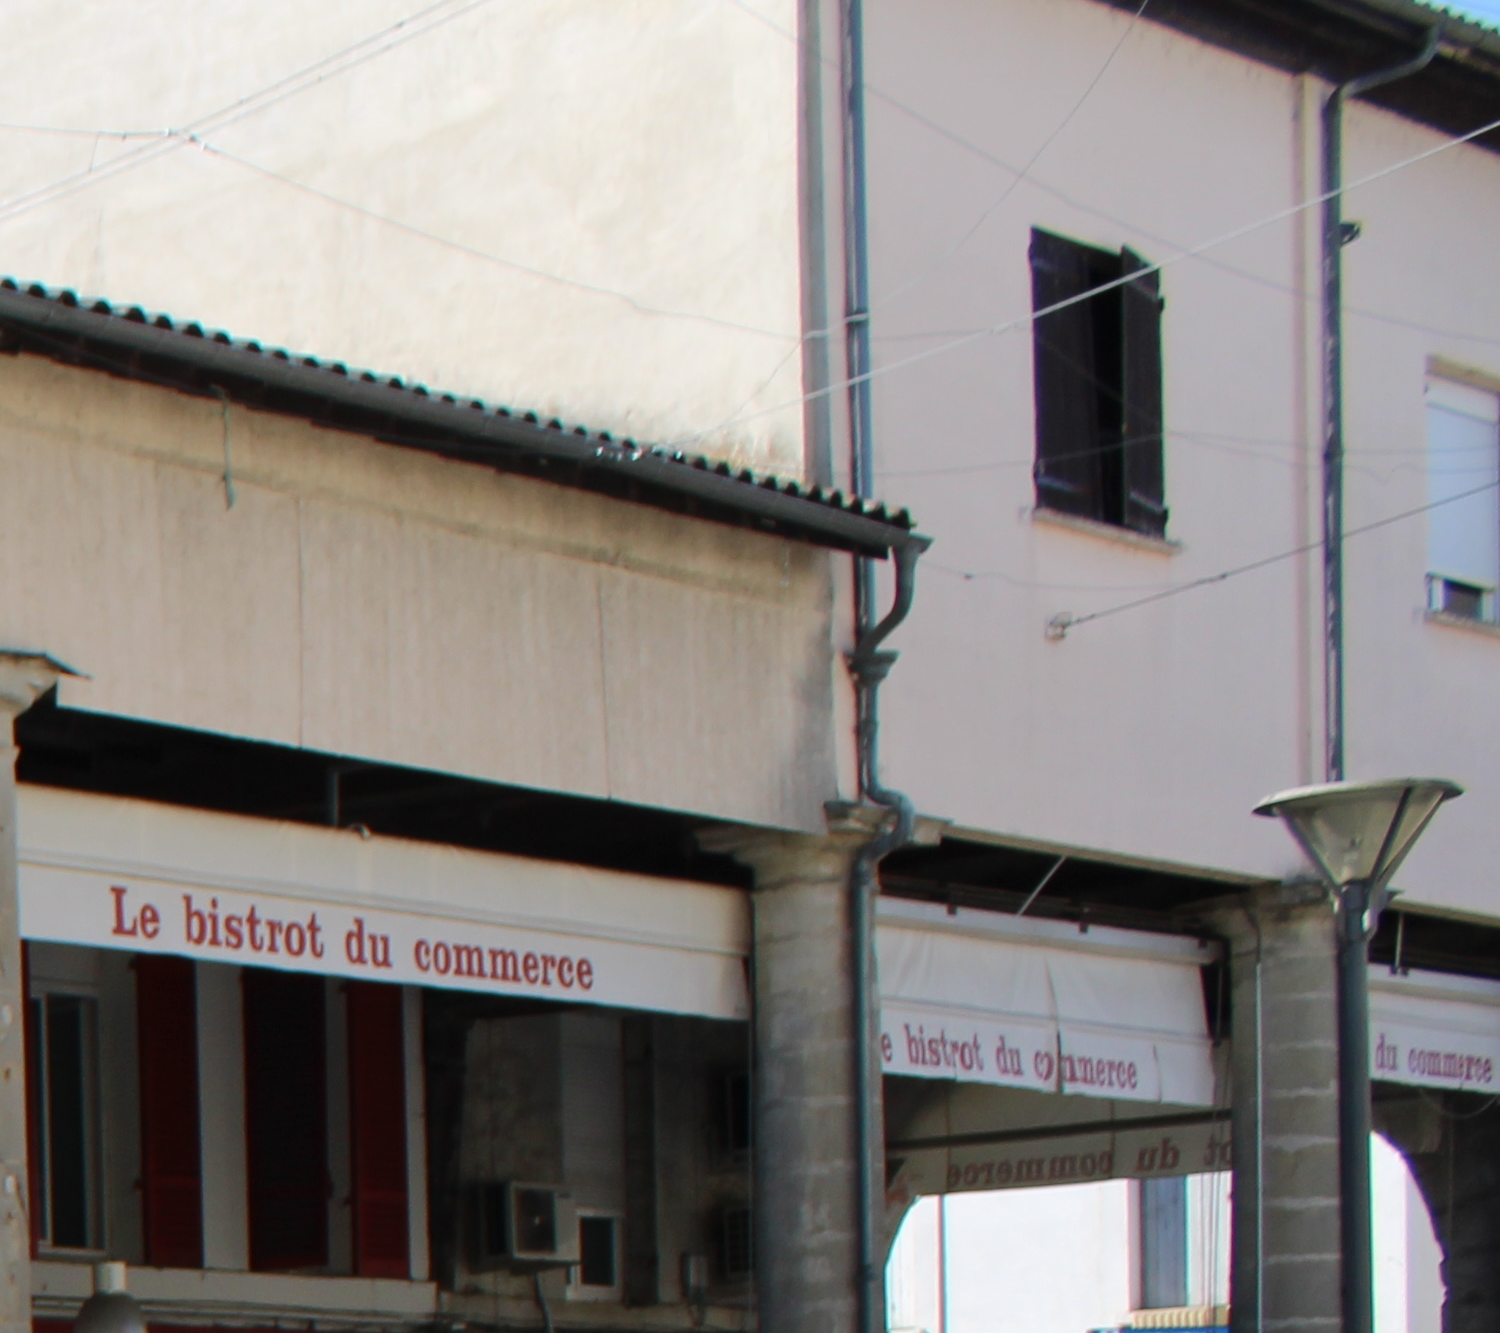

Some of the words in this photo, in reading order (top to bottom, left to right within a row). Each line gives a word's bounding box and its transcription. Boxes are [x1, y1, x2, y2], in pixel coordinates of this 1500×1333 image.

[111, 886, 160, 940] Le
[183, 895, 324, 961] bistrot
[345, 919, 393, 969] du
[414, 938, 594, 990] commerce
[904, 1023, 984, 1072] bistrot
[996, 1035, 1024, 1076] du
[1375, 1032, 1397, 1071] du
